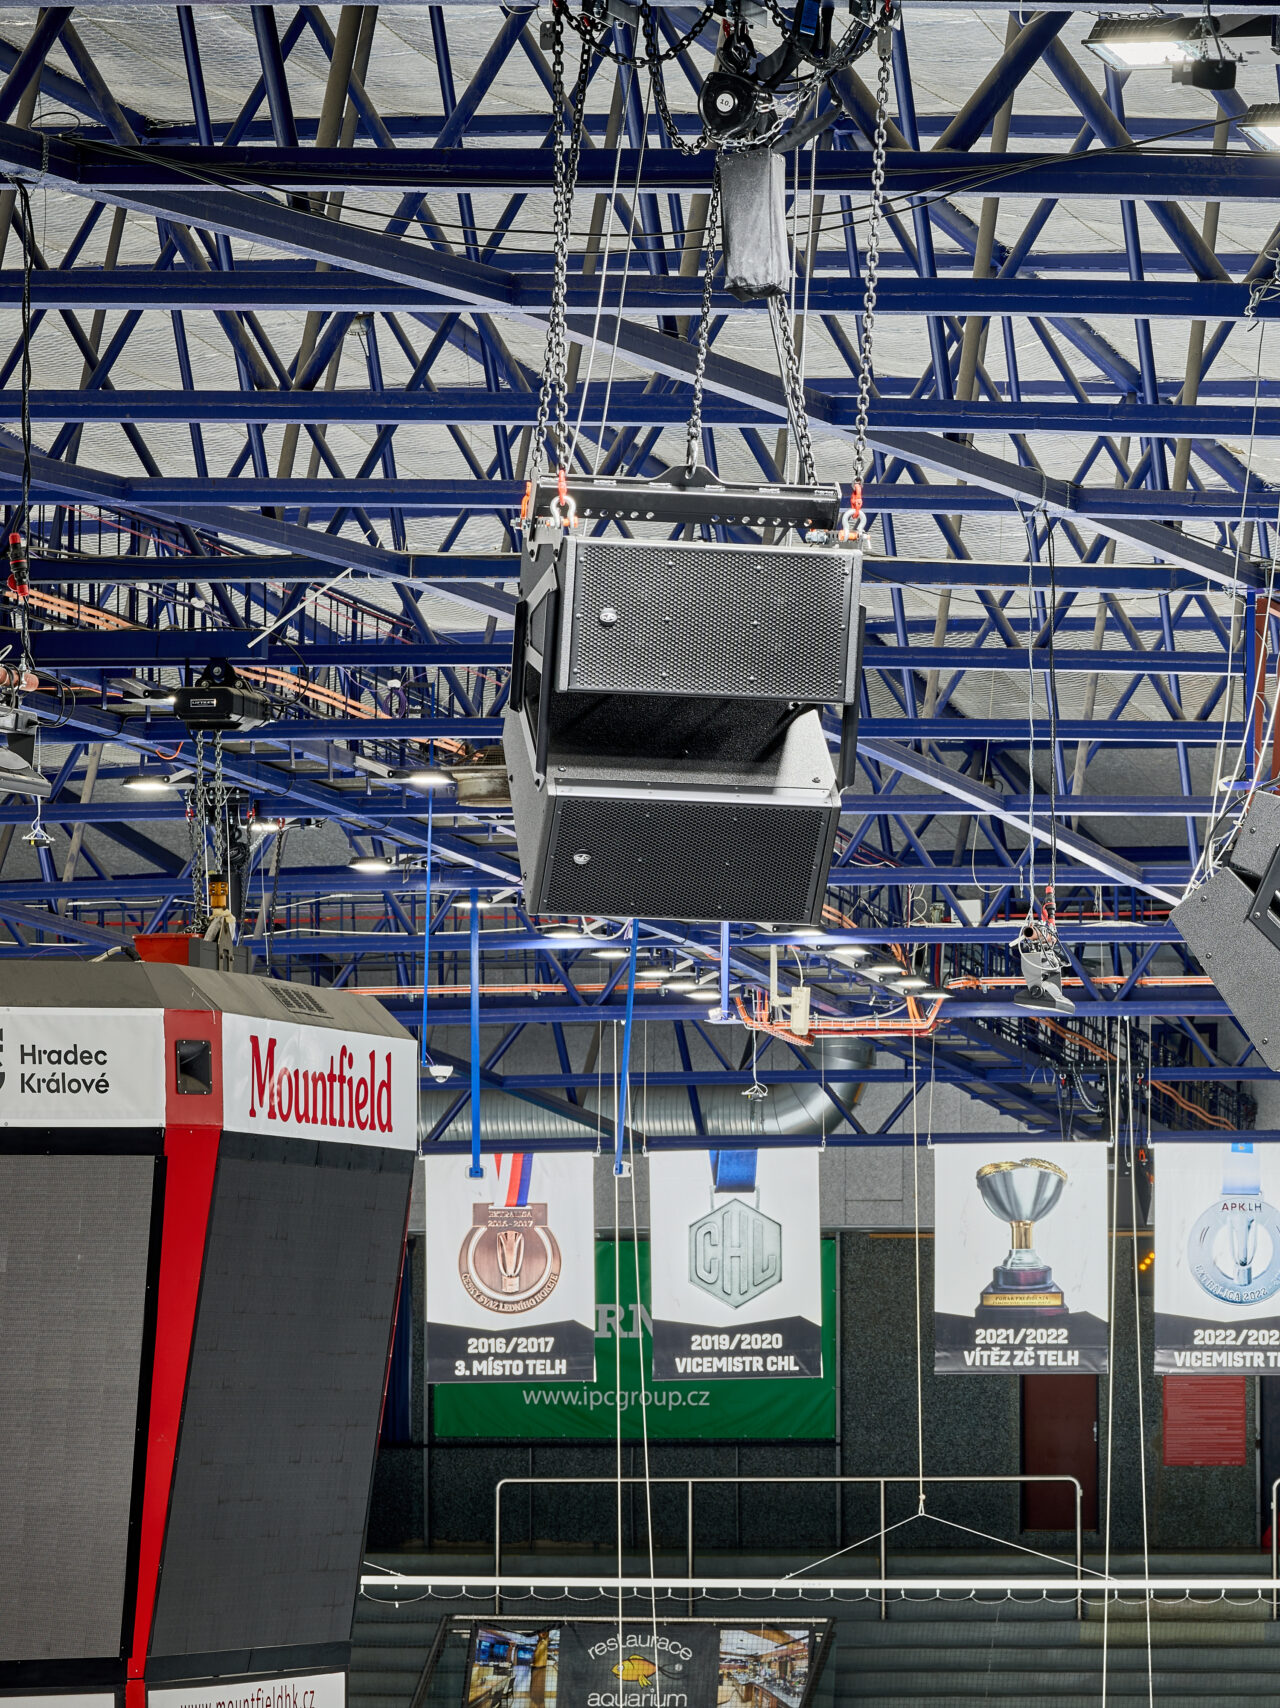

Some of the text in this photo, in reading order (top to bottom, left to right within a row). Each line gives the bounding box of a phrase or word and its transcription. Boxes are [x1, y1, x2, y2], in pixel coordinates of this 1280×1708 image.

[20, 1044, 108, 1066] Hradec
[20, 1072, 109, 1095] Králové
[248, 1035, 393, 1134] Mountfield
[695, 1211, 777, 1296] CHL
[467, 1337, 555, 1354] 2016/2017
[691, 1333, 783, 1350] 2019/2020
[975, 1328, 1069, 1344] 2021/2022
[454, 1356, 567, 1376] 3. MÍSTO TELH
[675, 1355, 800, 1373] VICEMISTR CHL
[963, 1346, 1079, 1366] VÍTĚZ ZČ TELH
[1174, 1352, 1265, 1368] VICEMISTR
[522, 1386, 710, 1411] www.ipcgroup.cz
[587, 1633, 693, 1660] restaurace
[587, 1688, 688, 1707] aquarium
